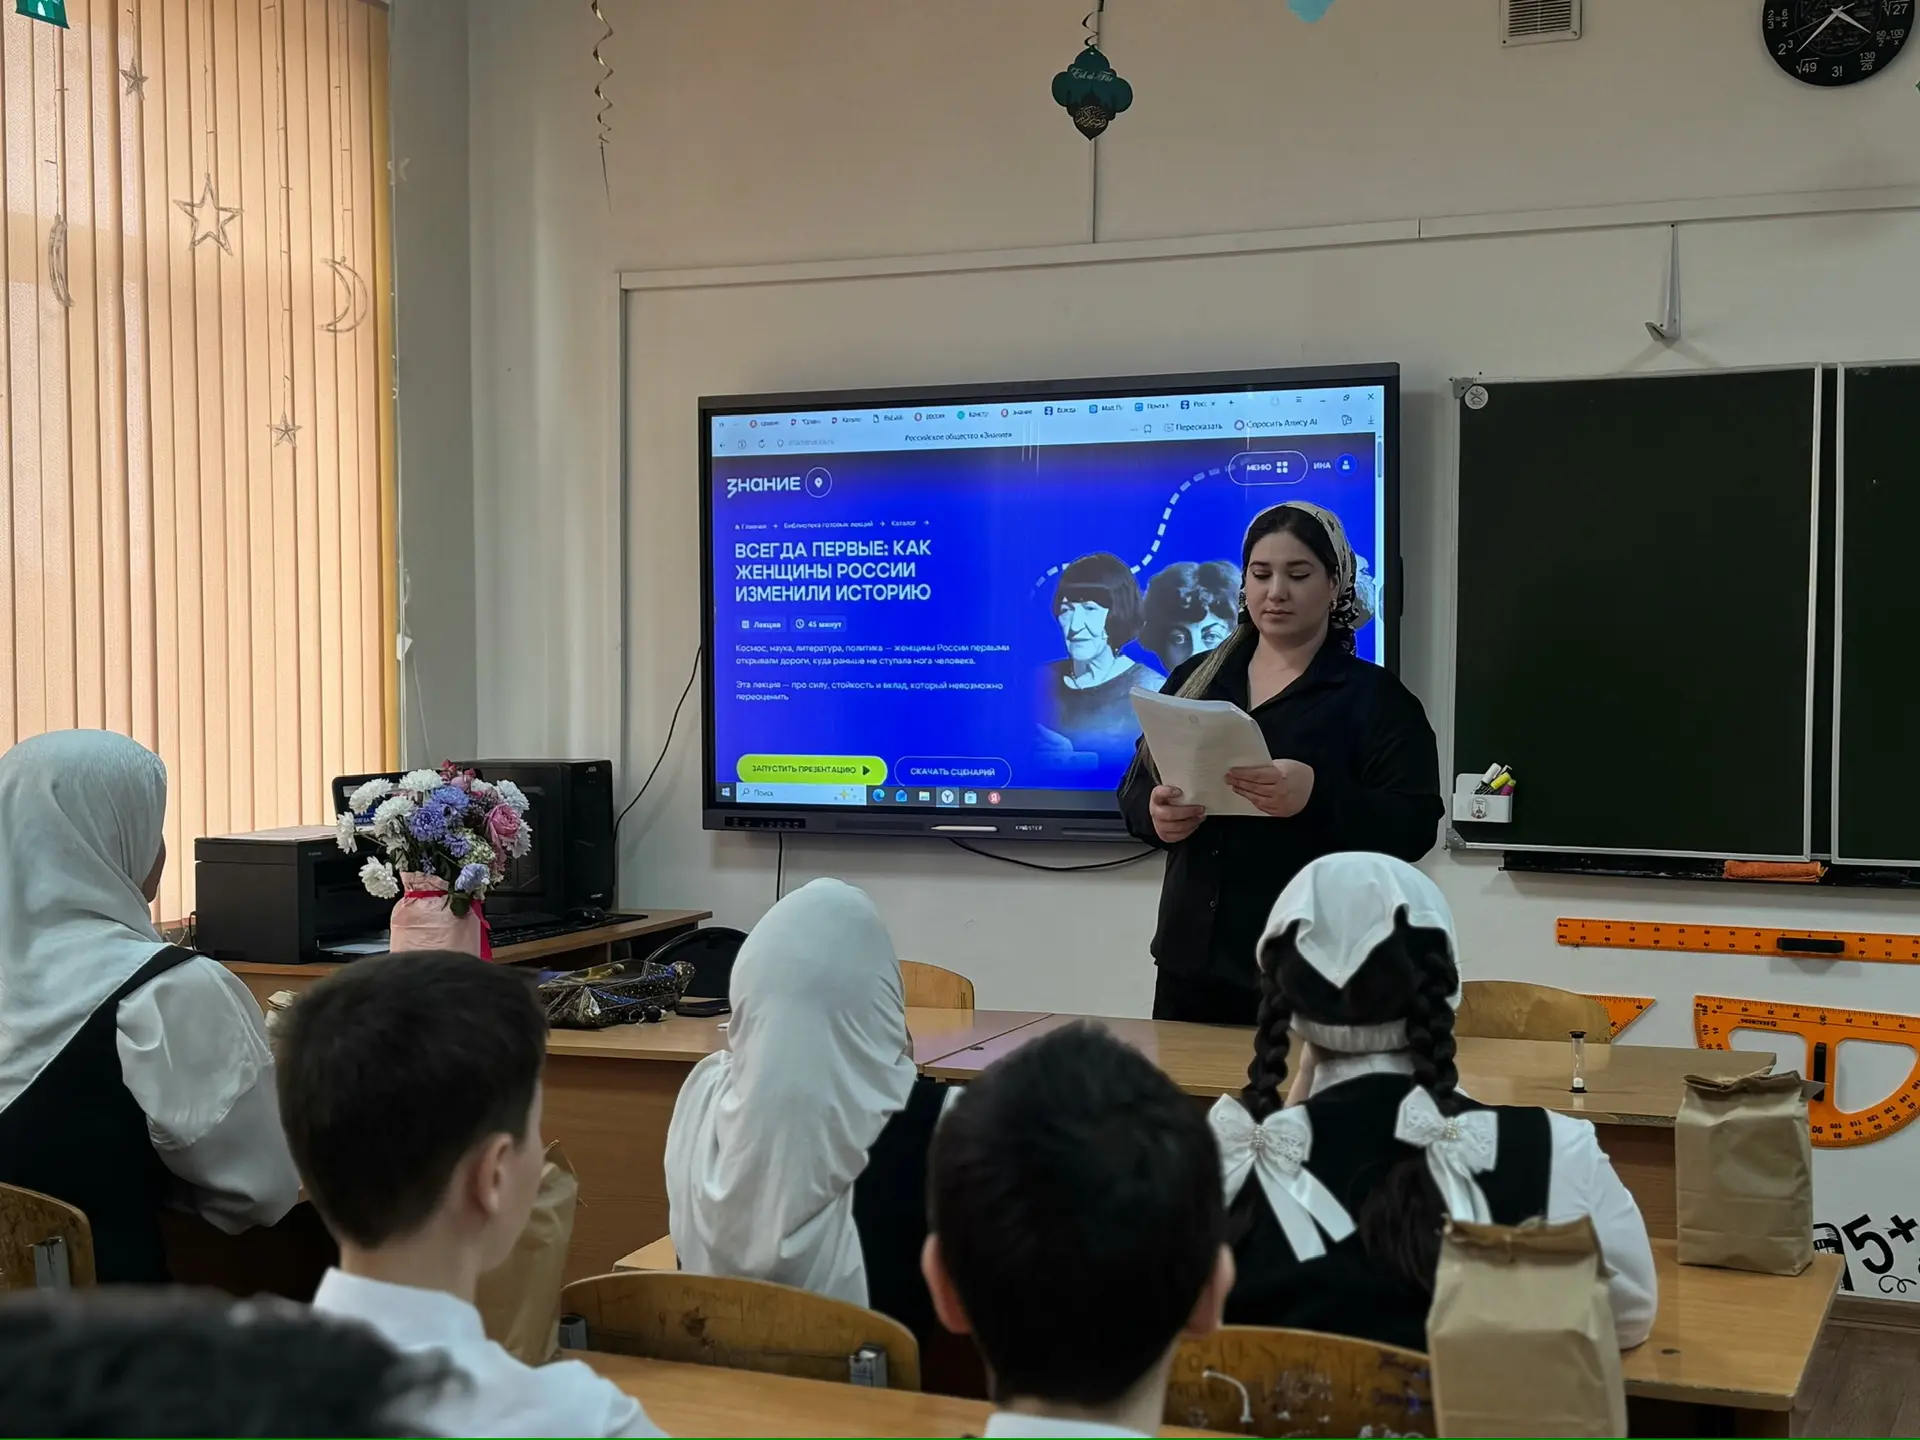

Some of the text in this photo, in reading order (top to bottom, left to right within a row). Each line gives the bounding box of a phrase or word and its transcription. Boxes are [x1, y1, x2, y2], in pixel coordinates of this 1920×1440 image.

[1176, 423, 1222, 432] Пересказать
[1247, 420, 1283, 430] Спросить
[1247, 463, 1272, 471] МЕНЮ
[735, 540, 931, 560] ВСЕГДА ПЕРВЫЕ: КАК
[735, 562, 916, 582] ЖЕНЩИНЫ РОССИИ
[735, 584, 931, 602] ИЗМЕНИЛИ ИСТОРИЮ
[753, 621, 781, 630] Лекция
[819, 621, 842, 629] минут
[735, 644, 768, 653] Космос,
[770, 645, 794, 654] наука,
[796, 645, 844, 653] литература,
[894, 645, 935, 653] женщины
[937, 644, 969, 652] России
[970, 645, 1010, 653] первыми
[736, 658, 778, 666] открывали
[780, 658, 811, 666] дороги,
[813, 658, 830, 666] куда
[833, 658, 865, 666] раньше
[879, 658, 912, 666] ступала
[736, 681, 751, 689] Эта
[753, 682, 781, 690] лекция
[792, 682, 807, 690] про
[808, 682, 830, 690] силу,
[831, 681, 874, 689] стойкость
[883, 682, 909, 690] вклад,
[910, 681, 947, 690] который
[752, 765, 856, 774] ЗАПУСТИТЬ ПРЕЗЕНТАЦИЮ
[910, 767, 995, 777] СКАЧАТЬ СЦЕНАРИЙ
[754, 789, 774, 797] Поиск
